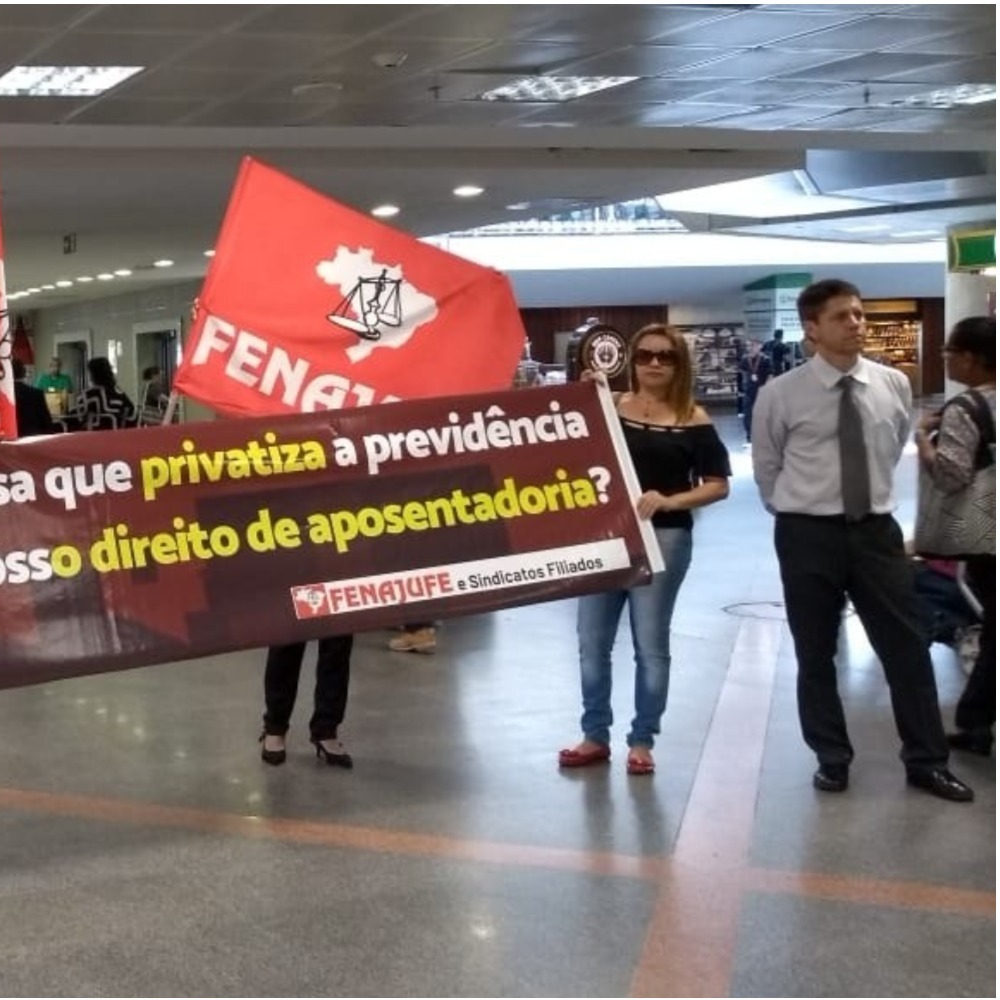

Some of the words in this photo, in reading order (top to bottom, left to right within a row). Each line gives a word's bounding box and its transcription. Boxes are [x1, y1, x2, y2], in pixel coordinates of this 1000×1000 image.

[45, 458, 132, 509] que
[141, 432, 326, 502] privatiza
[333, 434, 359, 466] a
[364, 403, 590, 474] previdência
[89, 516, 240, 573] direito
[247, 509, 300, 554] de
[306, 465, 612, 553] aposentadoria?
[329, 572, 452, 611] FENAJUFE
[458, 579, 467, 591] e
[469, 567, 545, 590] Sindicatos
[547, 556, 603, 577] Filiados
